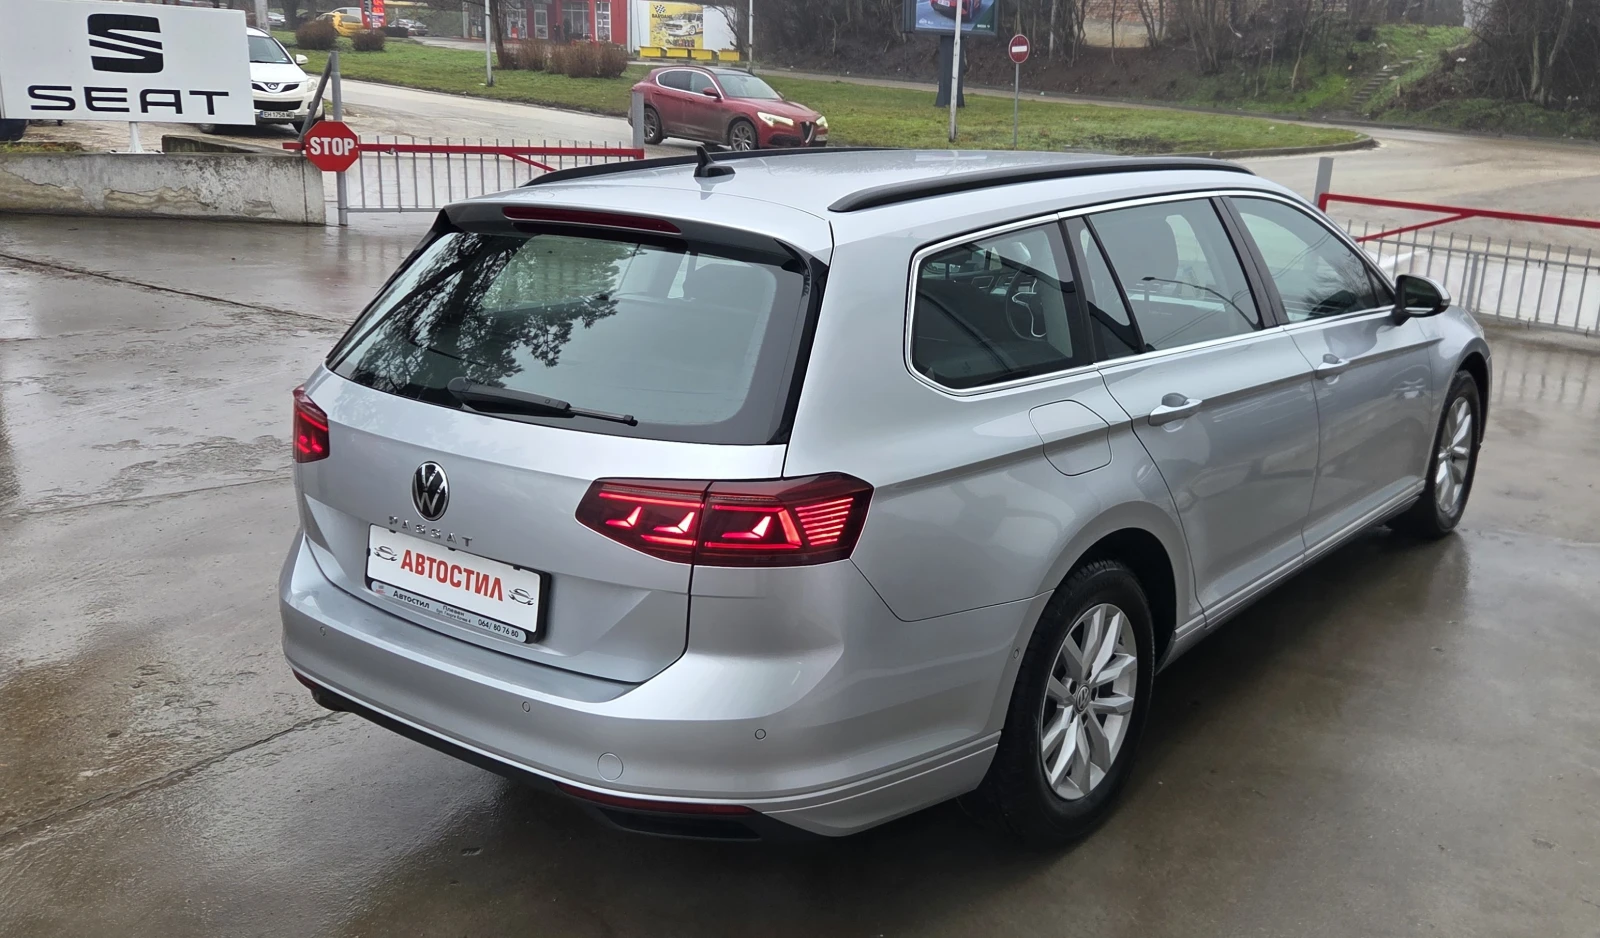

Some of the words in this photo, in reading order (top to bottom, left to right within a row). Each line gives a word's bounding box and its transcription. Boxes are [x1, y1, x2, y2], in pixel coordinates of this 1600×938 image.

[27, 84, 230, 116] SEAT
[309, 136, 355, 156] STOP
[388, 515, 473, 547] PASSAT
[400, 549, 504, 602] АВТОСТИЛ
[392, 589, 431, 609] Автостил
[477, 618, 493, 630] 064/
[493, 623, 502, 632] 80
[502, 626, 510, 635] 76
[510, 629, 519, 638] 80
